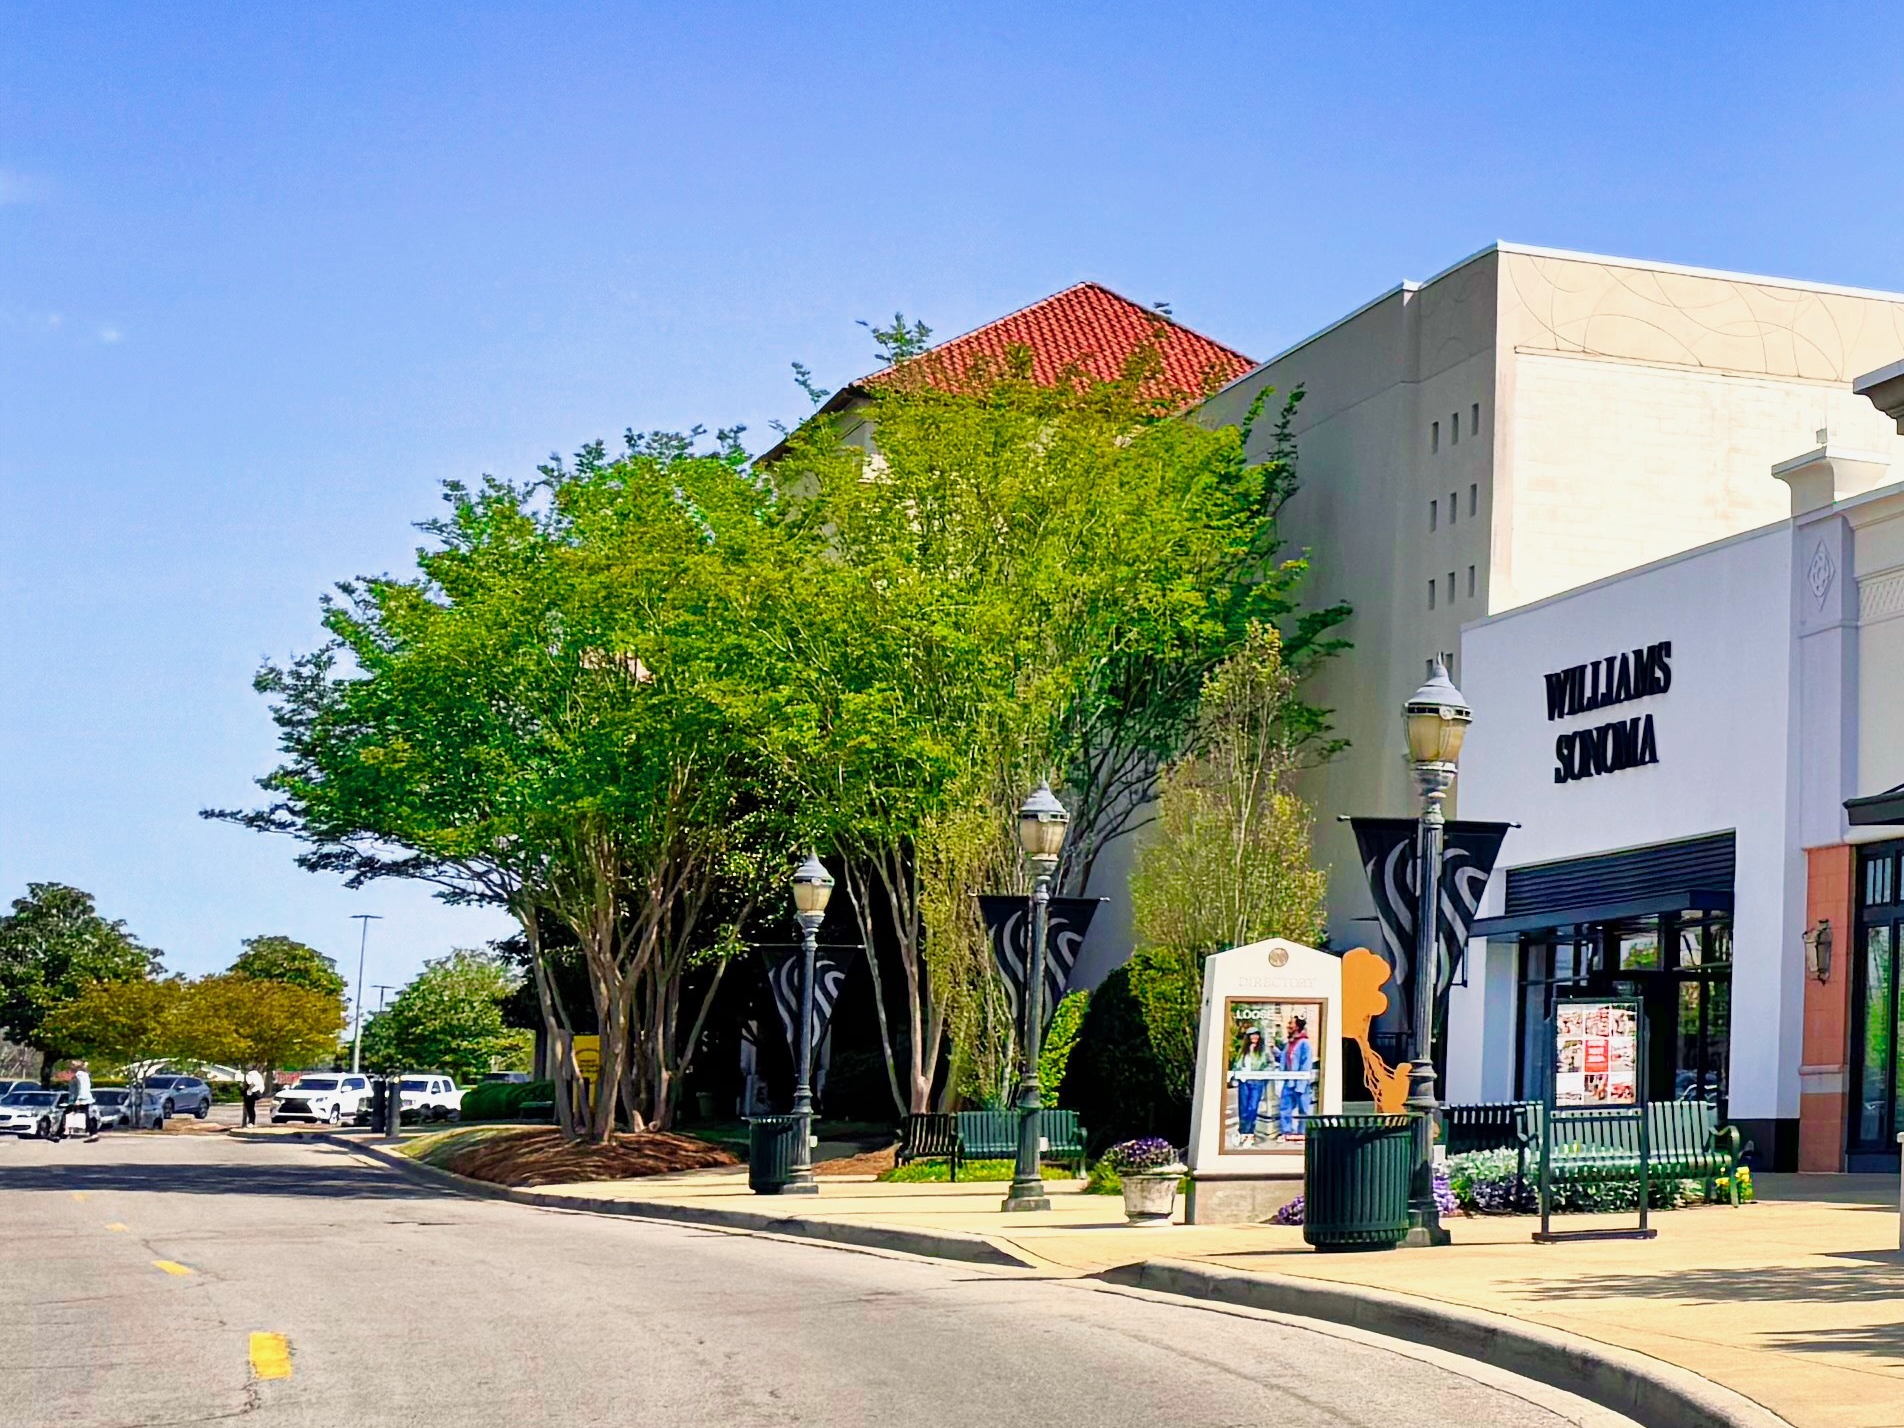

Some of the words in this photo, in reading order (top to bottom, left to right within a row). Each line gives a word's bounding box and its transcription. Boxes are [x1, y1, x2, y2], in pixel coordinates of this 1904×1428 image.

[1543, 641, 1672, 721] WILLIAMS
[1554, 714, 1660, 784] SONOMA
[1238, 976, 1318, 988] DIRECTORY
